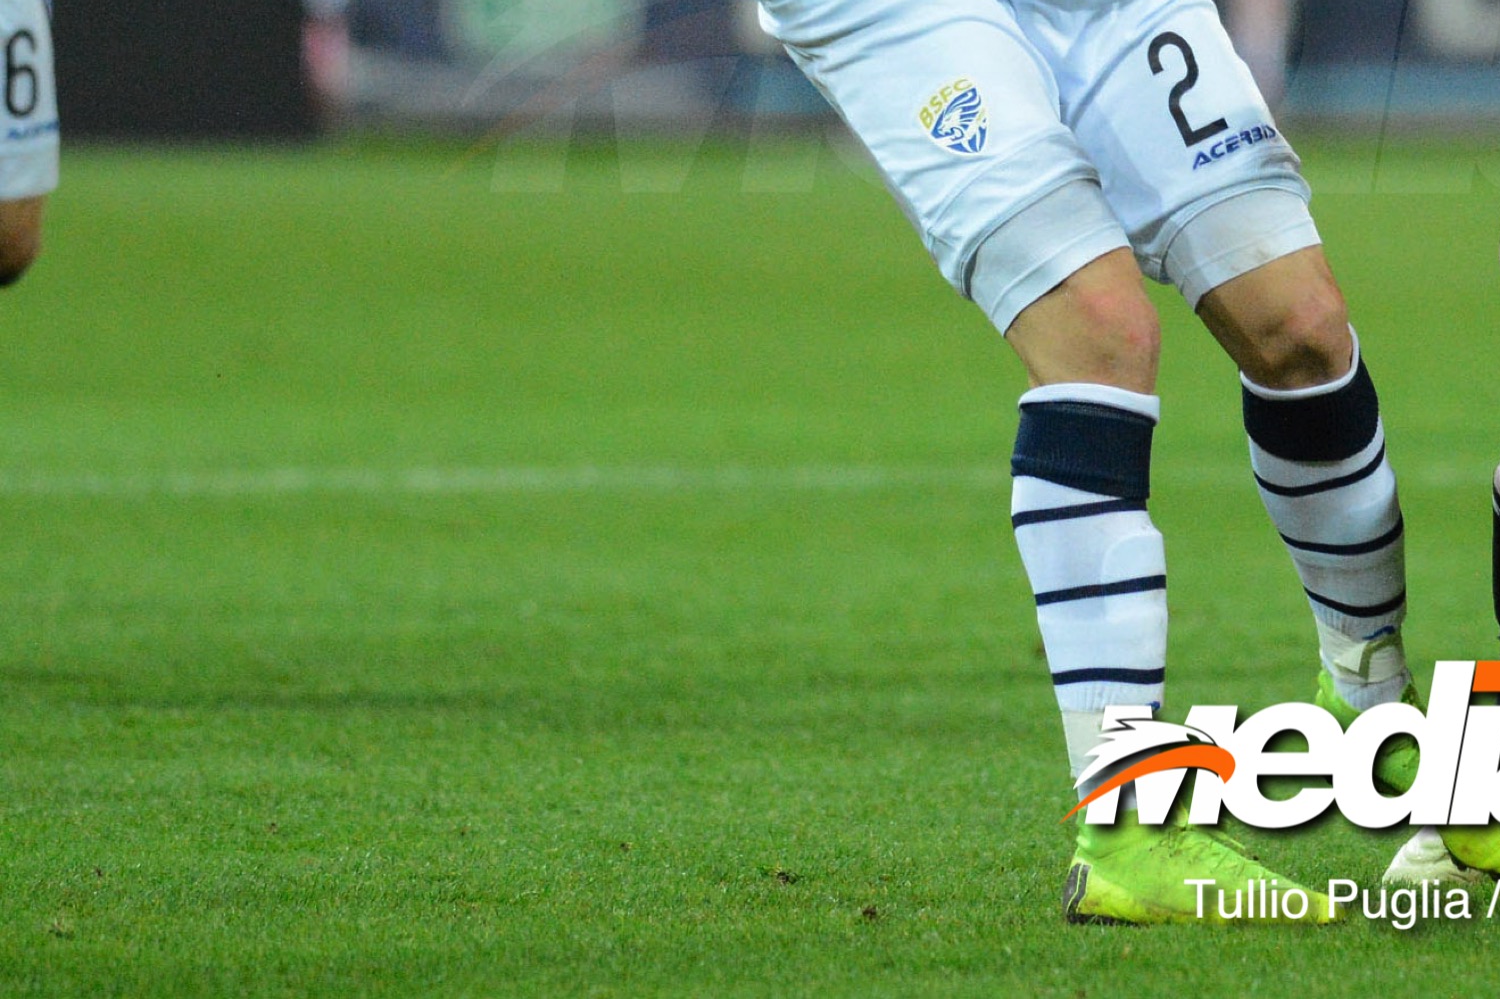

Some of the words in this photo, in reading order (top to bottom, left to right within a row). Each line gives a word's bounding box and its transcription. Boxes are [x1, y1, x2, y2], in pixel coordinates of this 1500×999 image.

[5, 29, 38, 118] 6
[919, 79, 974, 130] BSFC
[1147, 31, 1229, 148] 2
